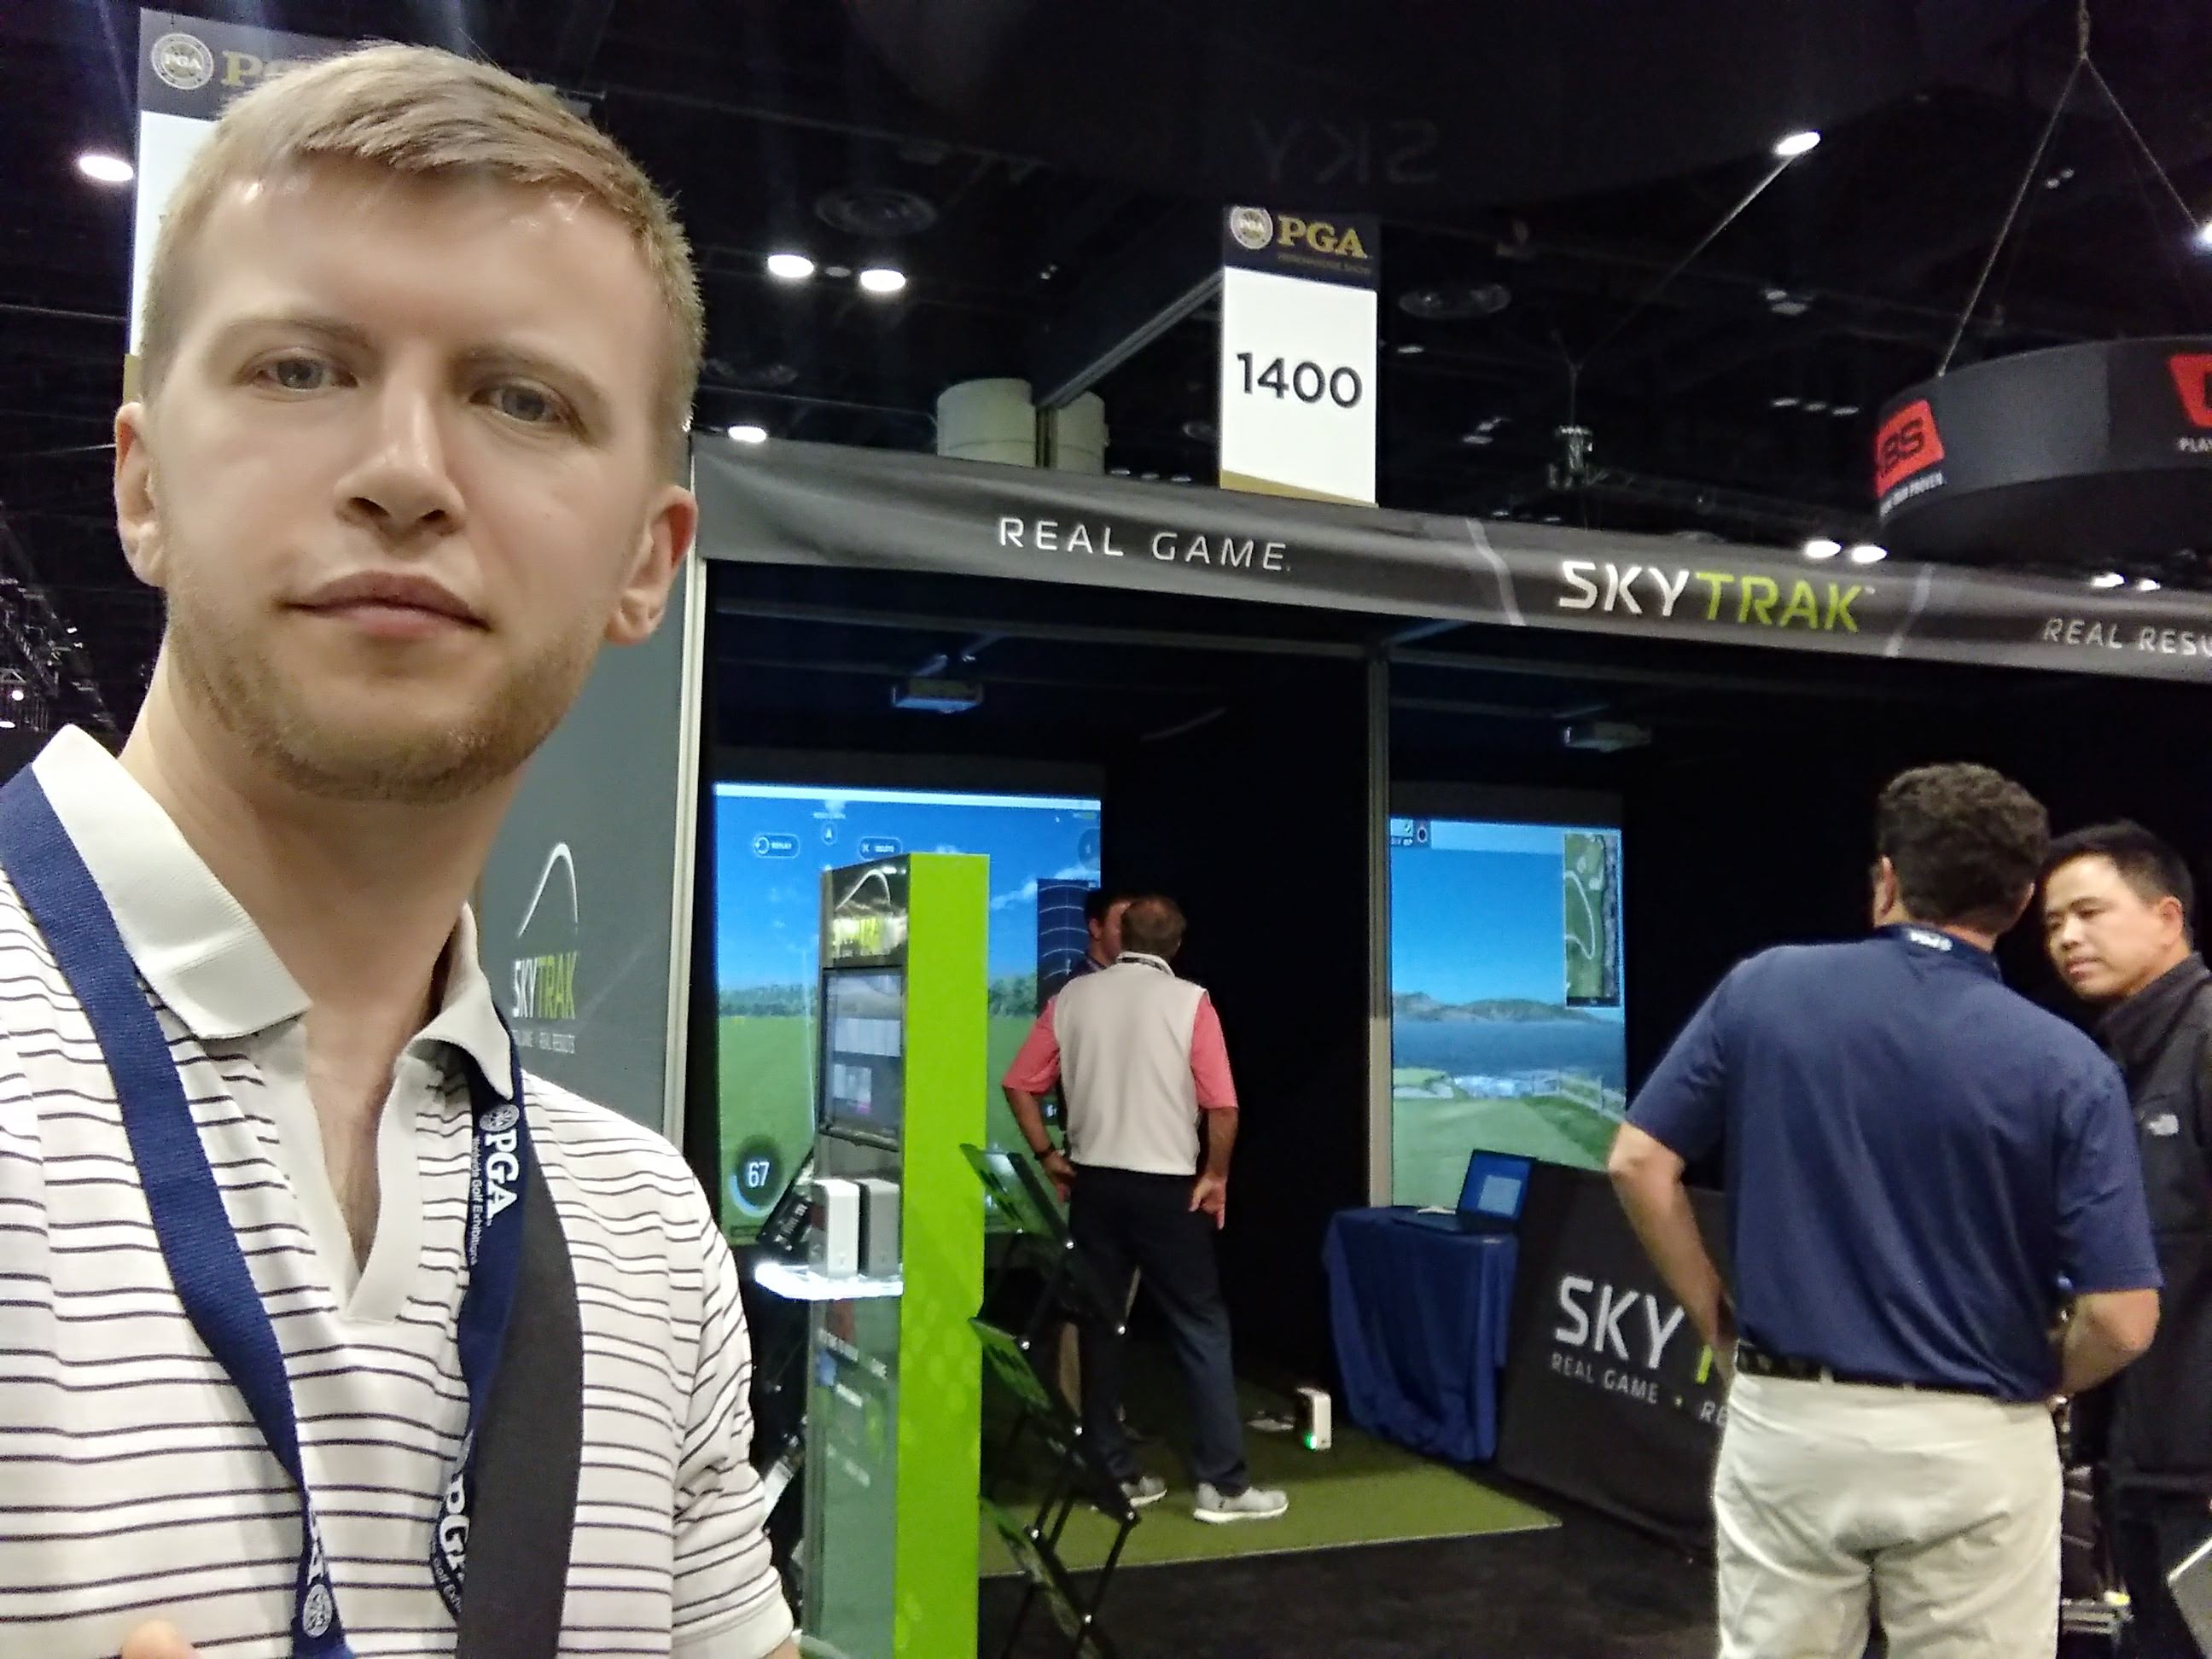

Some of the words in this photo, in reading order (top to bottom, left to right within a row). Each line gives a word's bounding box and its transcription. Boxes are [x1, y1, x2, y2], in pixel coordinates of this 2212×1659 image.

[1278, 215, 1368, 259] PGA
[1237, 352, 1363, 410] 1400
[998, 517, 1123, 556] REAL
[1558, 560, 1862, 633] SKYTRAK
[2043, 617, 2123, 649] REAL
[512, 952, 576, 1020] SKYTRAK
[471, 1179, 483, 1203] Golf
[485, 1129, 520, 1220] PGA
[748, 1161, 770, 1188] 67
[1551, 1352, 1594, 1383] REAL
[1603, 1370, 1659, 1404] GAME
[1699, 1400, 1731, 1428] RE
